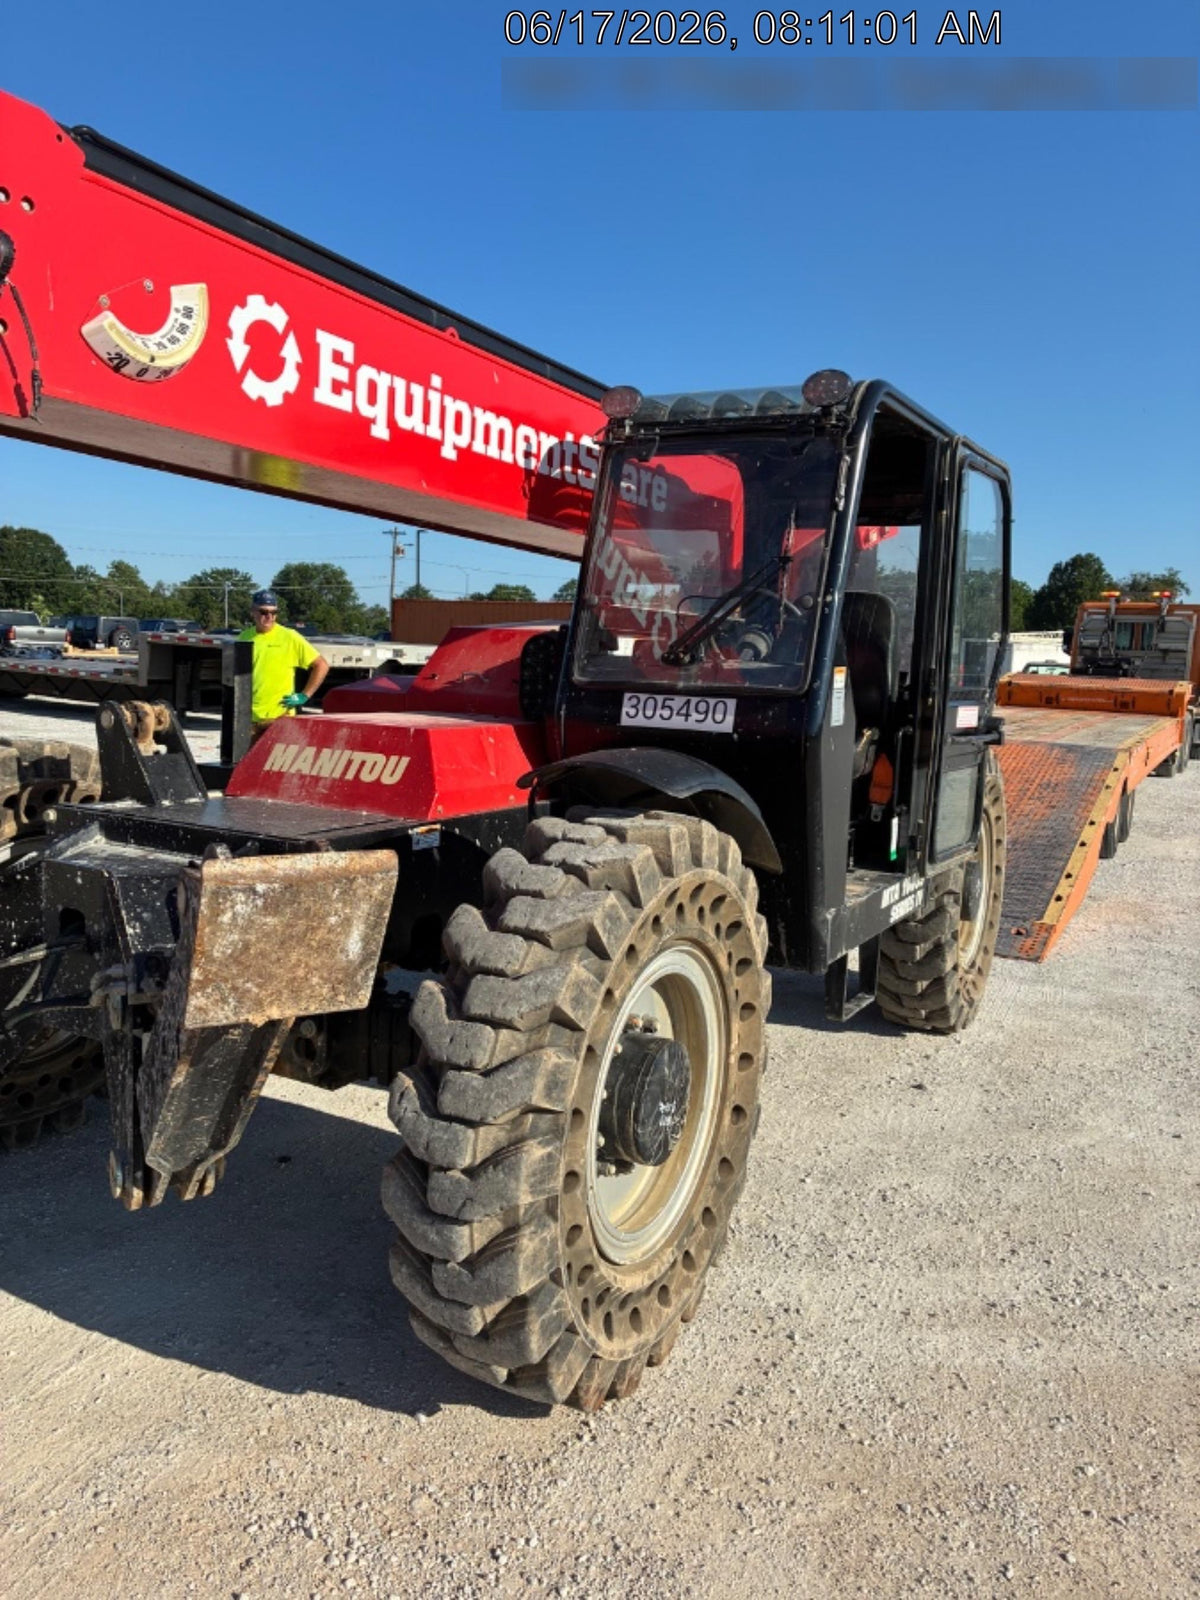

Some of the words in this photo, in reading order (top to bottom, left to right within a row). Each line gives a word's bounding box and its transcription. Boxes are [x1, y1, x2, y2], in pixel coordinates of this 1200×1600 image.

[106, 351, 130, 374] -20
[136, 367, 149, 378] 0
[313, 327, 668, 512] EquipmentSare
[624, 694, 728, 725] 305490
[262, 742, 411, 786] MANITOU
